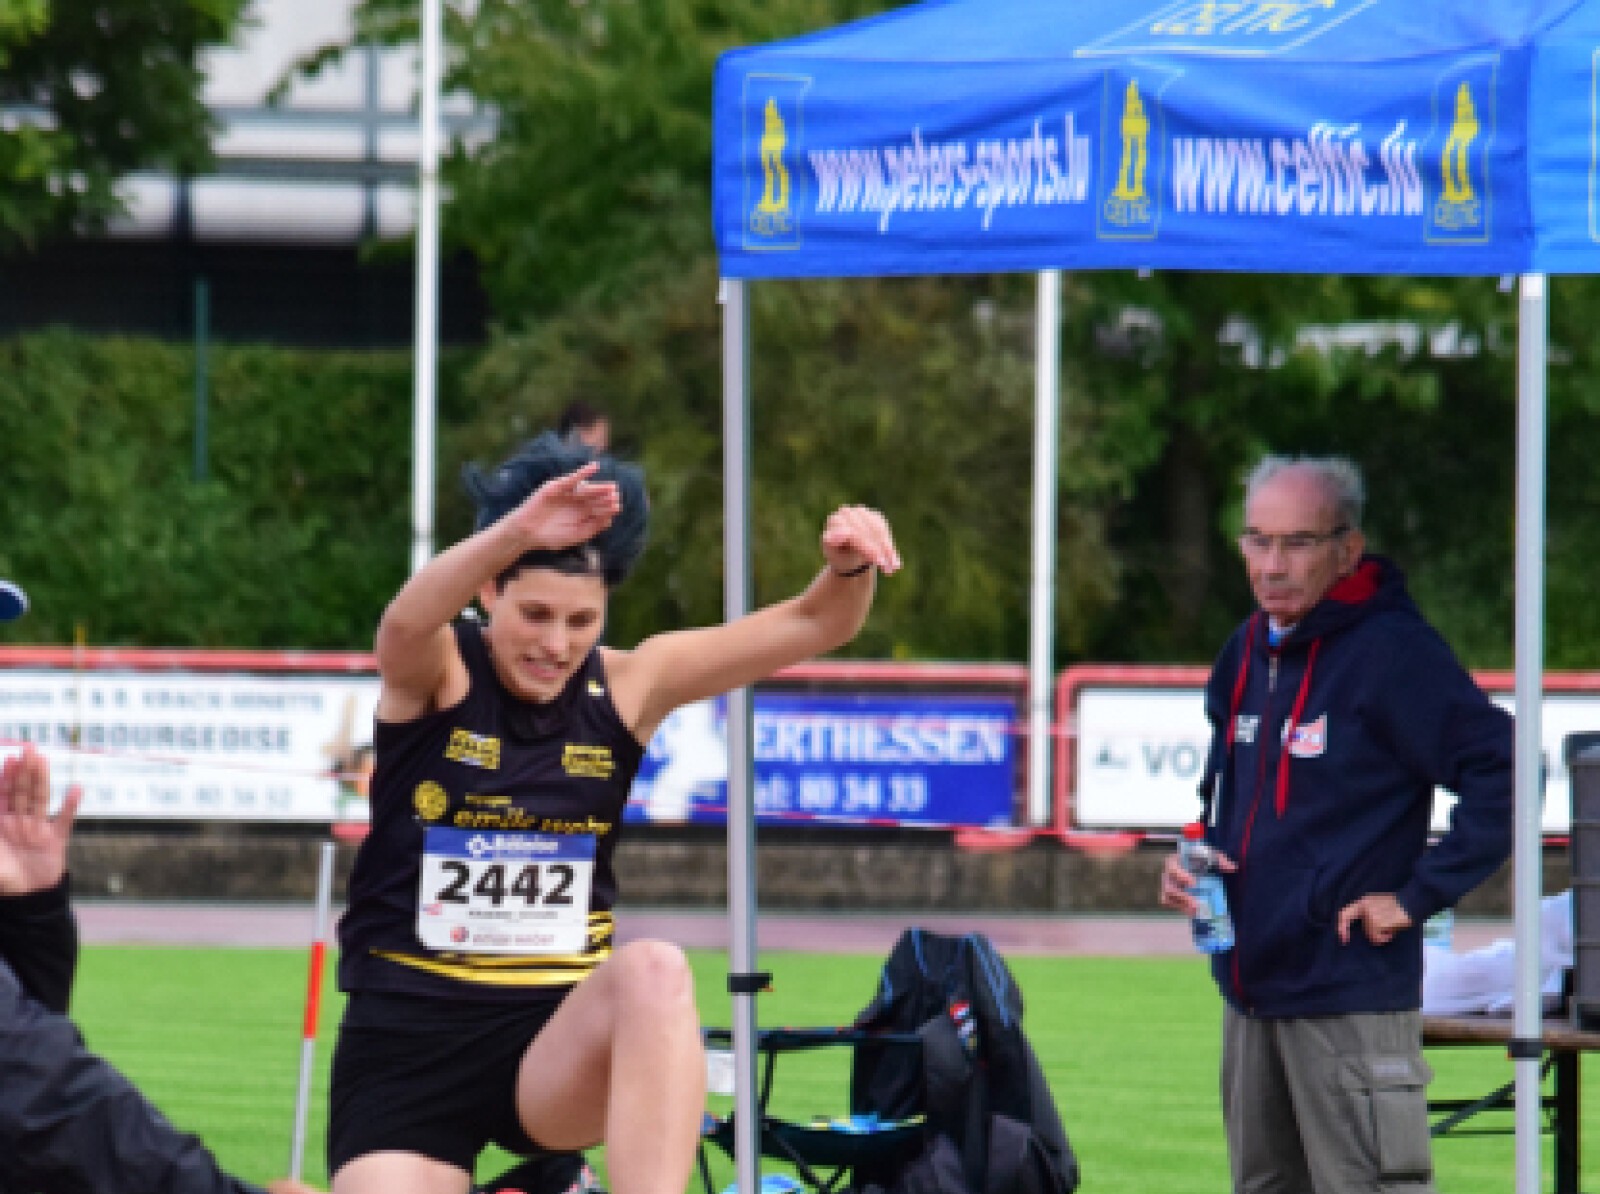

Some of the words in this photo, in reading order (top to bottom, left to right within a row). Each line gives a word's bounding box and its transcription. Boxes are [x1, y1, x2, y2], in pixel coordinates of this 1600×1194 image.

[808, 112, 1090, 233] www.peters-sports.lu
[1172, 119, 1425, 216] www.celtic.lu
[753, 712, 1007, 764] ERTHESSEN
[1140, 742, 1208, 777] VO
[436, 860, 575, 908] 2442
